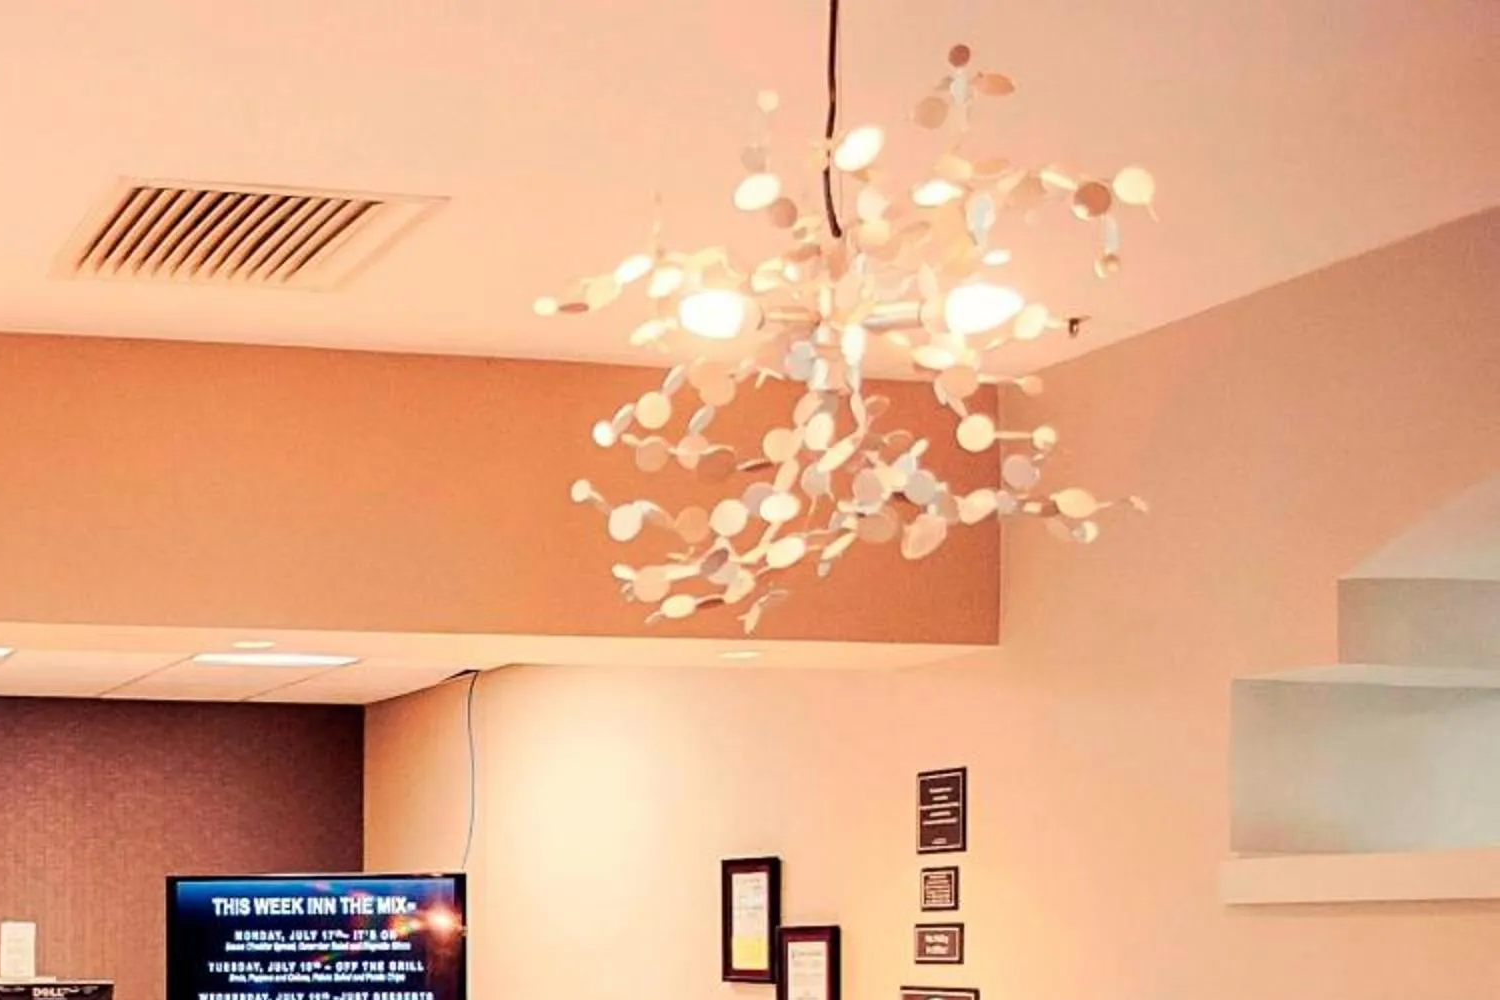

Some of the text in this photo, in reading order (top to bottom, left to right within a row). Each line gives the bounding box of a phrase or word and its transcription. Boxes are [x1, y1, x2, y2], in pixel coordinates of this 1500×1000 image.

[212, 897, 251, 916] THIS
[253, 897, 304, 916] WEEK
[307, 897, 336, 915] INN
[340, 897, 374, 915] THE
[234, 930, 285, 942] MONDAY,
[289, 930, 318, 941] JULY
[208, 962, 263, 973] TUESDAY,
[268, 962, 296, 972] JULY
[362, 961, 385, 972] THE
[389, 961, 424, 972] GRILL
[32, 987, 65, 997] DELL
